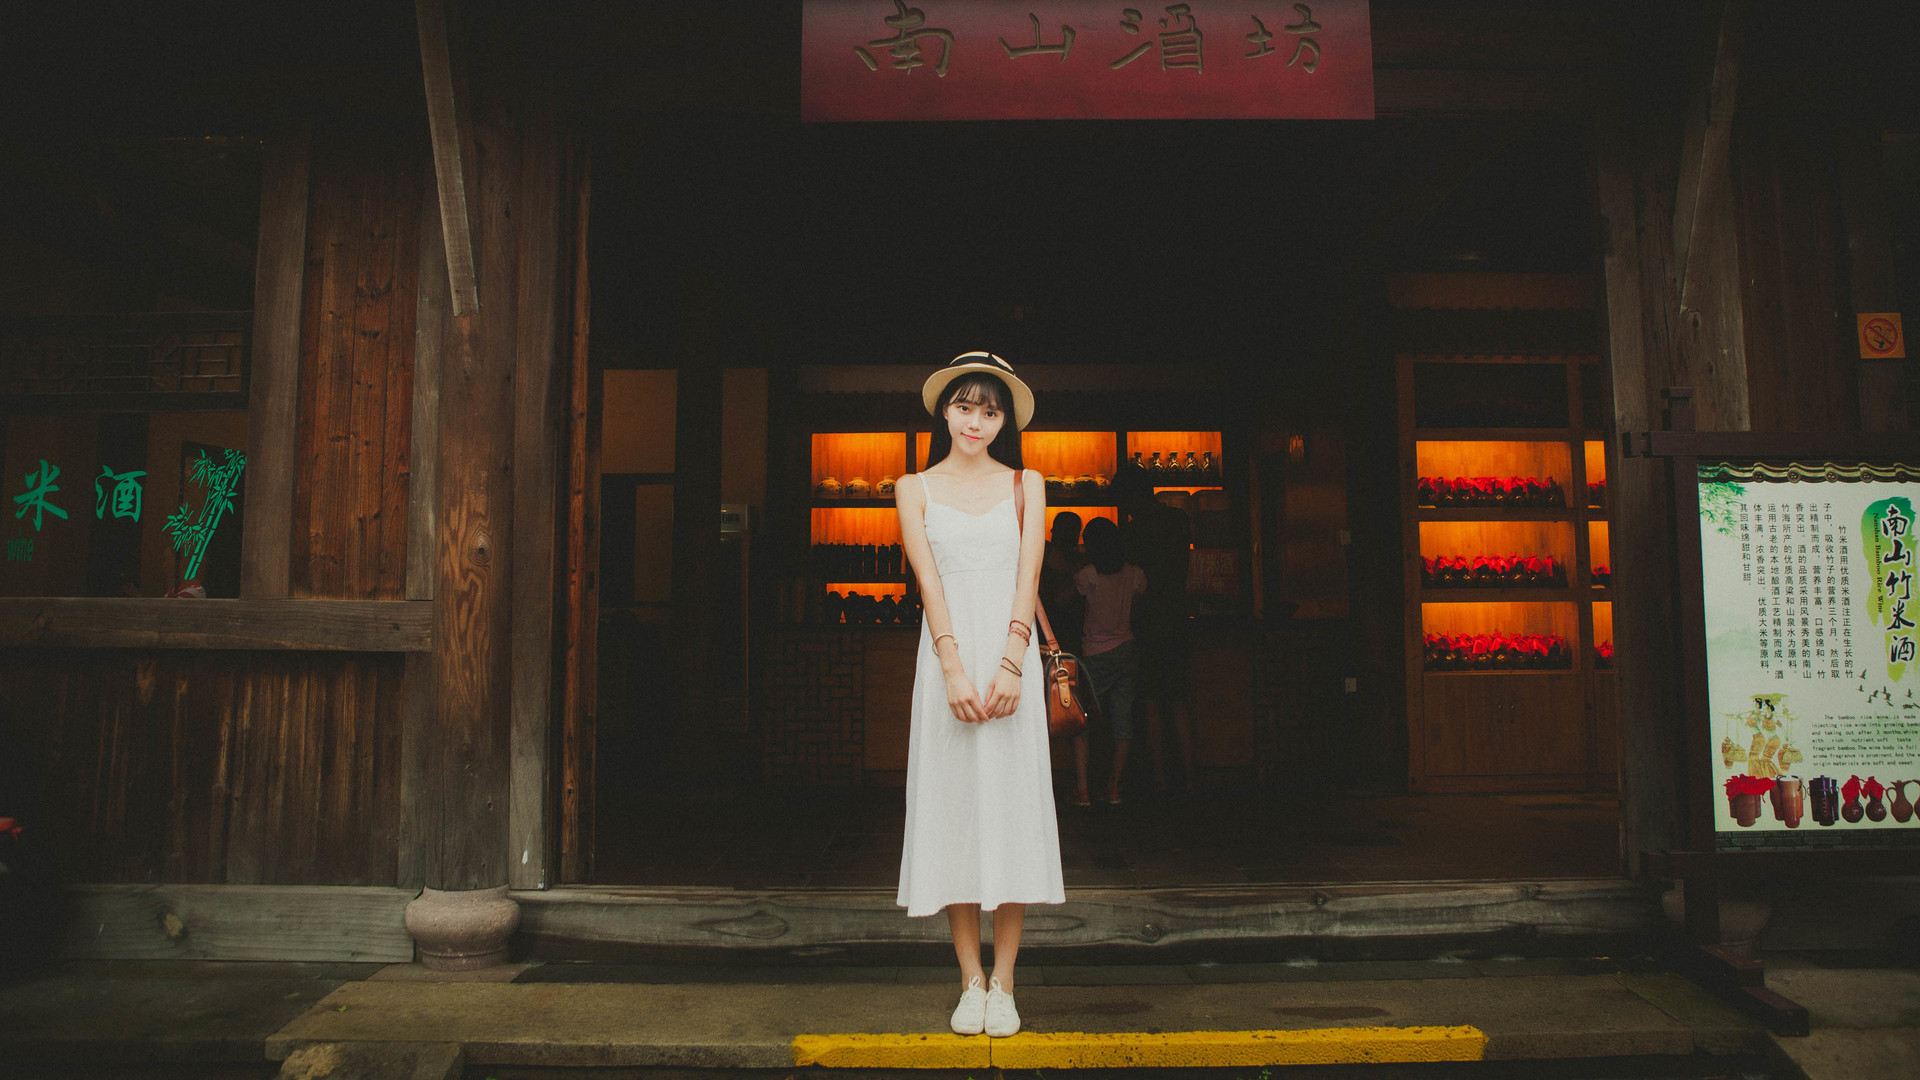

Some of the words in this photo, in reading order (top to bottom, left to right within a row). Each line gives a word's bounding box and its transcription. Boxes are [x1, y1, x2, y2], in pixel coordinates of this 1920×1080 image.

[853, 0, 1322, 77] 南山酒坊
[13, 459, 148, 532] 米酒
[1882, 506, 1916, 662] 南山竹米酒
